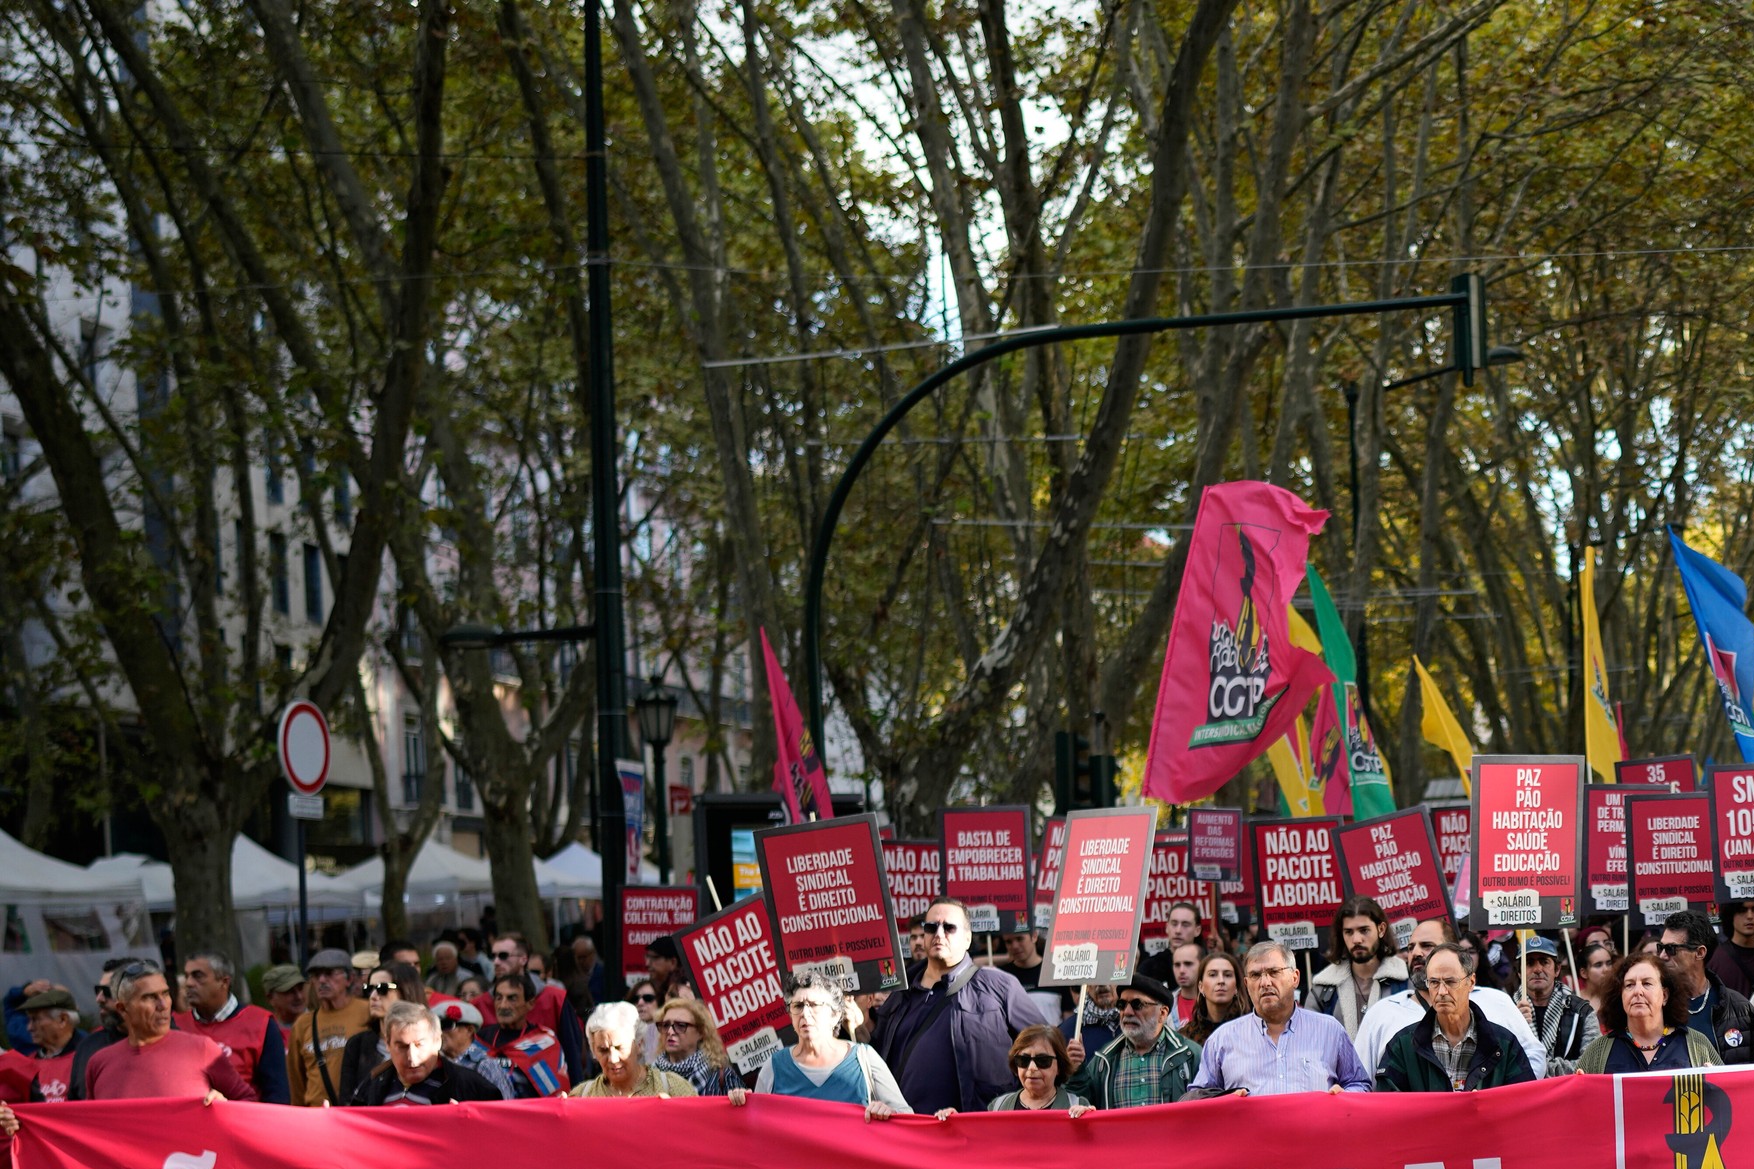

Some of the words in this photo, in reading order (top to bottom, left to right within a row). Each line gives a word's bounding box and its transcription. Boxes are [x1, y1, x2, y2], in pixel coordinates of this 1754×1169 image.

[1210, 676, 1265, 718] CGTP
[1352, 752, 1384, 772] CGTP
[1516, 769, 1541, 787] PAZ
[1647, 765, 1665, 782] 35
[1516, 787, 1541, 807] PÃO
[1197, 815, 1233, 825] AUMENTO
[1493, 808, 1562, 832] HABITAÇÃO
[1647, 816, 1699, 830] LIBERDADE
[958, 830, 993, 847] BASTA
[996, 830, 1010, 846] DE
[1208, 826, 1222, 836] DAS
[1371, 825, 1394, 843] PAZ
[1653, 830, 1696, 844] SINDICAL
[1080, 838, 1130, 856] LIBERDADE
[1194, 837, 1235, 847] REFORMAS
[1265, 827, 1300, 854] NÃO
[1306, 829, 1329, 851] AO
[1375, 841, 1398, 858] PÃO
[1507, 831, 1548, 850] SAÚDE
[948, 848, 1022, 864] EMPOBRECER
[1195, 848, 1200, 856] E
[1202, 845, 1234, 858] PENSÕES
[1653, 845, 1658, 859] É
[1661, 846, 1697, 858] DIREITO
[786, 849, 853, 874] LIBERDADE
[1081, 859, 1121, 875] SINDICAL
[1266, 855, 1333, 881] PACOTE
[1360, 852, 1421, 880] HABITAÇÃO
[1494, 851, 1560, 874] EDUCAÇÃO
[1636, 860, 1714, 875] CONSTITUCIONAL
[796, 869, 852, 892] SINDICAL
[948, 867, 955, 881] A
[959, 865, 1024, 881] TRABALHAR
[1376, 871, 1414, 893] SAÚDE
[1483, 878, 1506, 887] OUTRO
[1508, 877, 1528, 886] RUMO
[1530, 874, 1535, 886] É
[1536, 874, 1570, 886] POSSÍVEL!
[1077, 876, 1084, 894] É
[1085, 878, 1120, 893] DIREITO
[1263, 881, 1342, 907] LABORAL
[626, 897, 693, 911] CONTRATAÇÃO
[799, 894, 807, 912] É
[809, 888, 856, 909] DIREITO
[1059, 896, 1133, 914] CONSTITUCIONAL
[1498, 894, 1531, 907] SALÁRIO
[1651, 901, 1680, 912] SALÁRIO
[624, 913, 672, 925] COLETIVA,
[674, 913, 694, 924] SIM!
[781, 904, 883, 934] CONSTITUCIONAL
[1501, 910, 1536, 922] DIREITOS
[693, 928, 735, 965] NÃO
[735, 912, 762, 947] AO
[1280, 926, 1308, 936] SALÁRIO
[789, 946, 813, 960] OUTRO
[814, 943, 837, 957] RUMO
[839, 938, 844, 953] É
[845, 937, 885, 954] POSSÍVEL!
[1284, 937, 1314, 948] DIREITOS
[1063, 950, 1090, 962] SALÁRIO
[703, 941, 775, 997] PACOTE
[1063, 965, 1093, 977] DIREITOS
[709, 972, 783, 1029] LABORA
[741, 1035, 770, 1055] SALÁRIO
